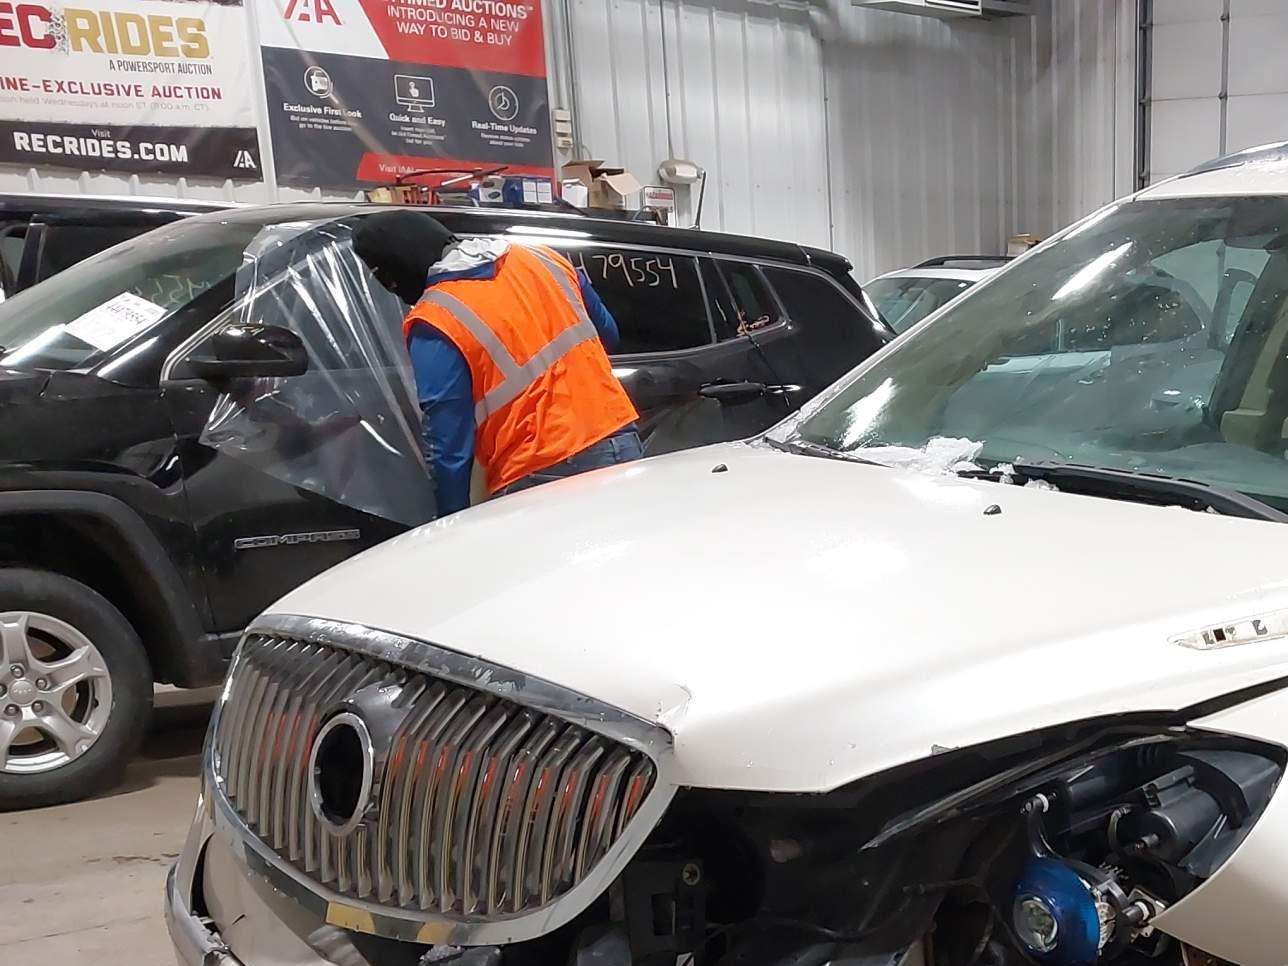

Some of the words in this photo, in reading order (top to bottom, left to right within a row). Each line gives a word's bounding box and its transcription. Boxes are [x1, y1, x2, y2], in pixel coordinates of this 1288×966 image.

[387, 5, 475, 27] INTRODUCING
[479, 17, 487, 28] A
[491, 18, 519, 32] NEW
[64, 8, 210, 59] RIDES
[396, 21, 426, 35] WAY
[429, 25, 447, 38] TO
[451, 28, 471, 41] BID
[474, 30, 483, 43] &
[487, 32, 513, 46] BUY
[109, 60, 116, 71] A
[117, 60, 176, 74] POWERSPORT
[178, 63, 213, 75] AUCTION
[152, 85, 222, 99] AUCTION
[283, 103, 322, 114] Exclusive
[324, 107, 341, 116] First
[389, 113, 410, 123] Quick
[412, 116, 426, 124] and
[428, 117, 446, 127] Easy
[472, 121, 508, 132] Real-Time
[509, 125, 537, 134] Updates
[91, 128, 111, 138] Visit
[13, 131, 188, 162] RECRIDES.COM
[234, 529, 361, 549] COMPASS
